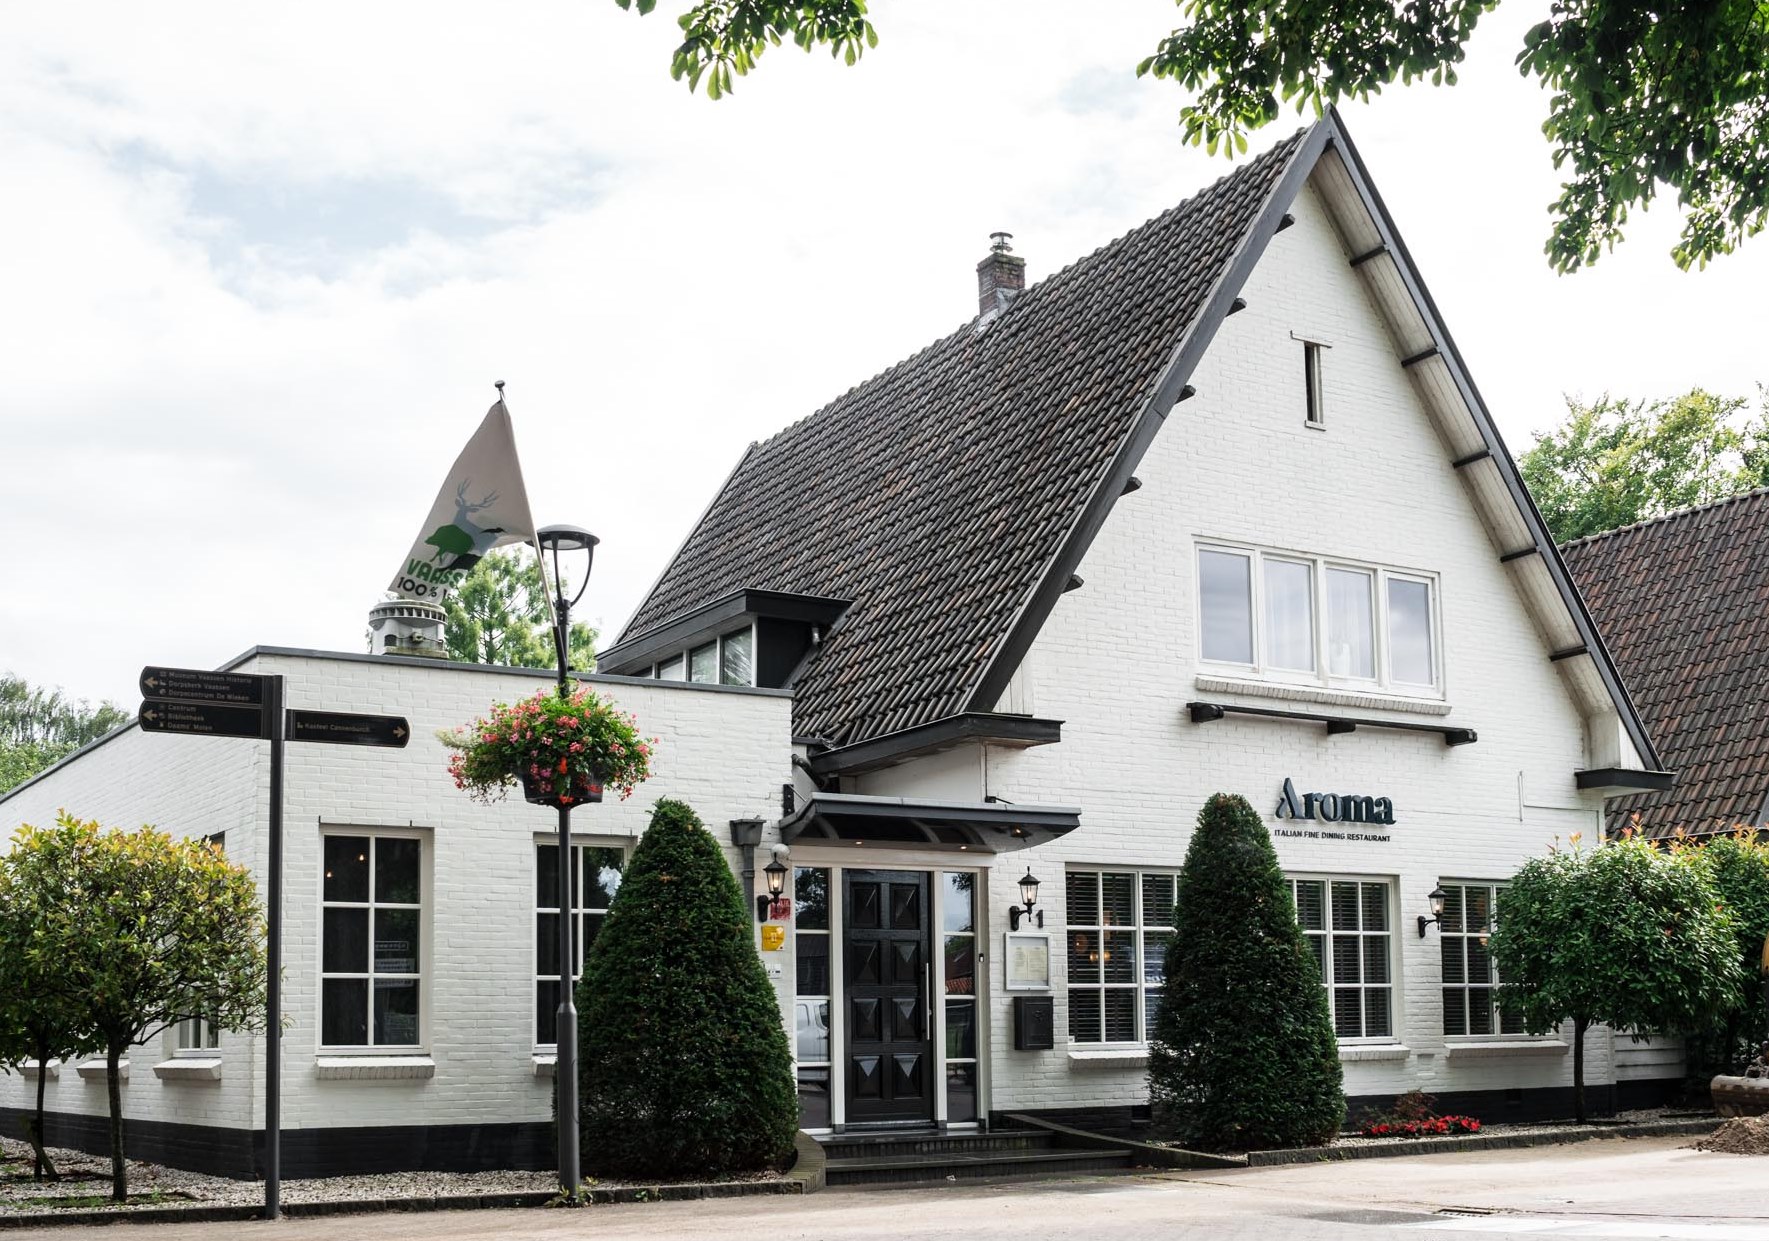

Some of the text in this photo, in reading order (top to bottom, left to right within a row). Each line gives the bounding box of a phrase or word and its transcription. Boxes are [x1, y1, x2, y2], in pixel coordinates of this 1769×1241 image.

[397, 577, 438, 598] 100%
[168, 713, 205, 721] Bibliotheek
[1275, 777, 1397, 825] Aroma
[1274, 829, 1391, 842] ITALIAN FINE DINING RESTAURANT
[1035, 909, 1043, 929] 1
